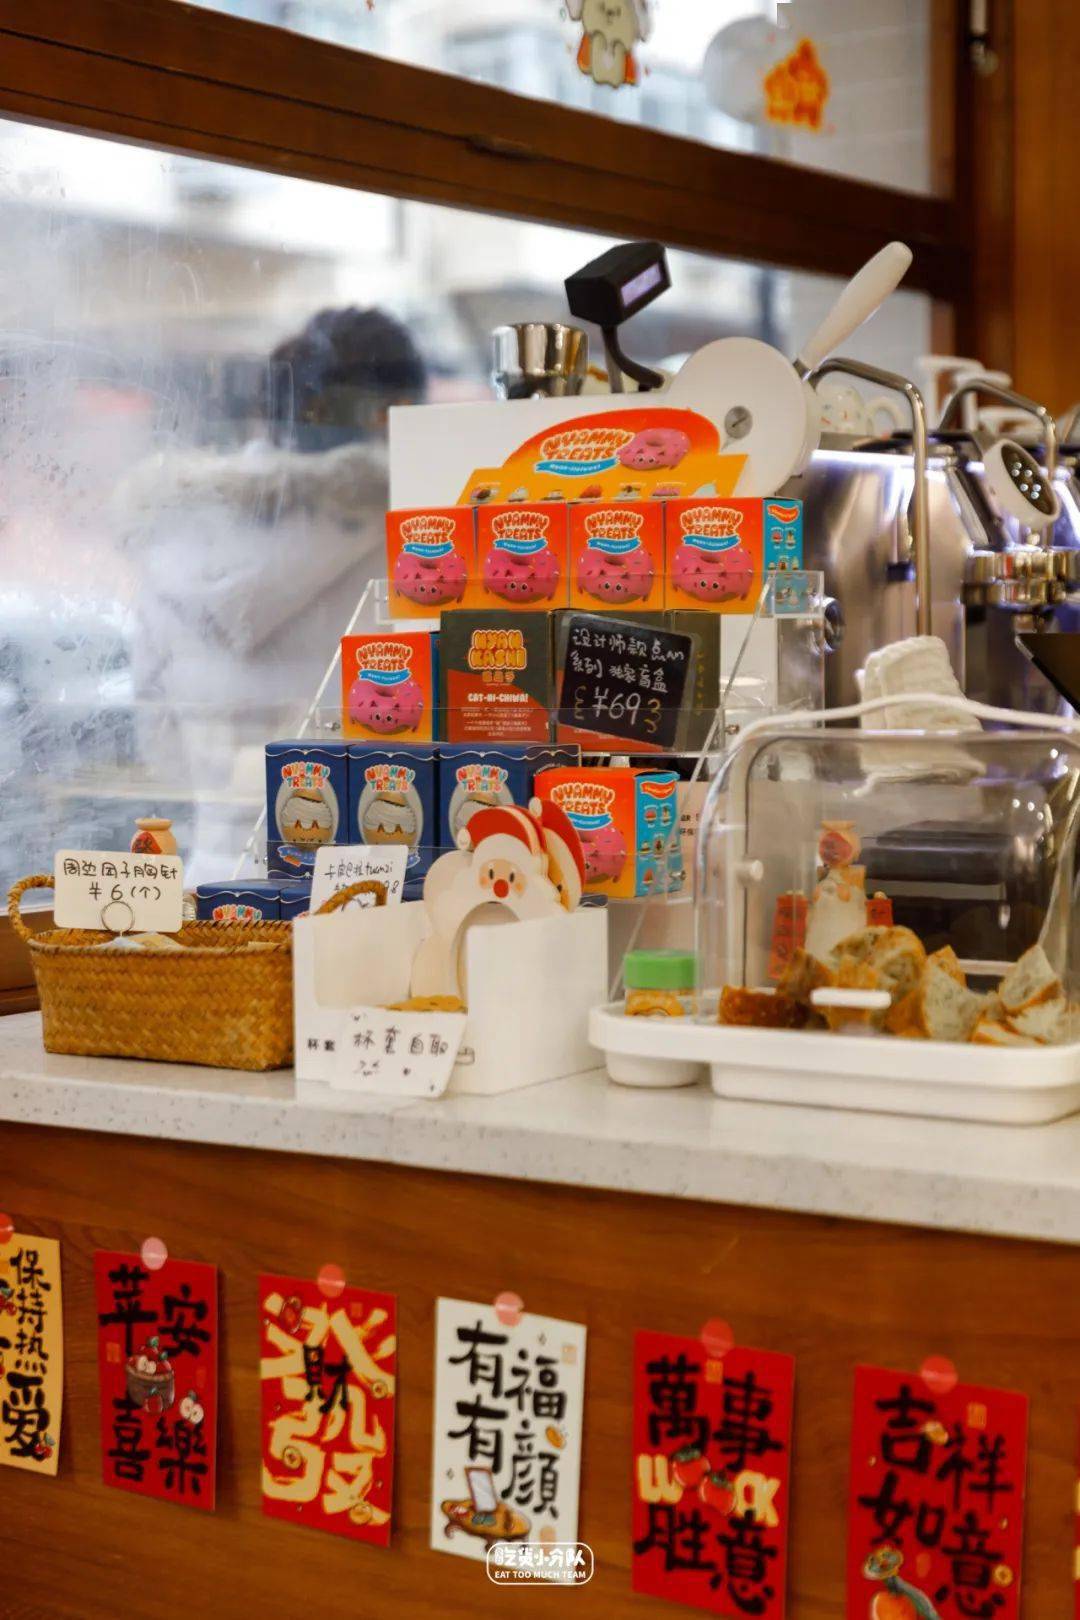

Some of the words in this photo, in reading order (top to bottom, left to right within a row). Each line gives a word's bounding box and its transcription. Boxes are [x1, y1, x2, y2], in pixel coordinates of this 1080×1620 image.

[540, 428, 636, 453] NYAMMY
[544, 446, 618, 461] TREATS
[401, 516, 456, 534] NYAMMY
[492, 511, 550, 532] NYAMMY
[584, 510, 644, 530] NYAMMY
[680, 506, 744, 528] NYAMMY
[406, 531, 449, 545] TREATS
[497, 527, 542, 541] TREATS
[589, 525, 638, 539] TREATS
[686, 522, 737, 537] TREATS
[473, 631, 523, 651] NYAN
[356, 642, 413, 660] NYAMMY
[469, 648, 527, 669] KASHI
[361, 656, 406, 671] TREATS
[570, 650, 603, 678] 系列
[592, 685, 641, 725] ¥69
[281, 762, 330, 779] NYAMMY
[364, 764, 416, 781] NYAMMY
[456, 764, 509, 781] NYAMMY
[286, 775, 324, 789] TREATS
[370, 778, 410, 792] TREATS
[462, 778, 502, 792] TREATS
[551, 783, 615, 803] NYAMMY
